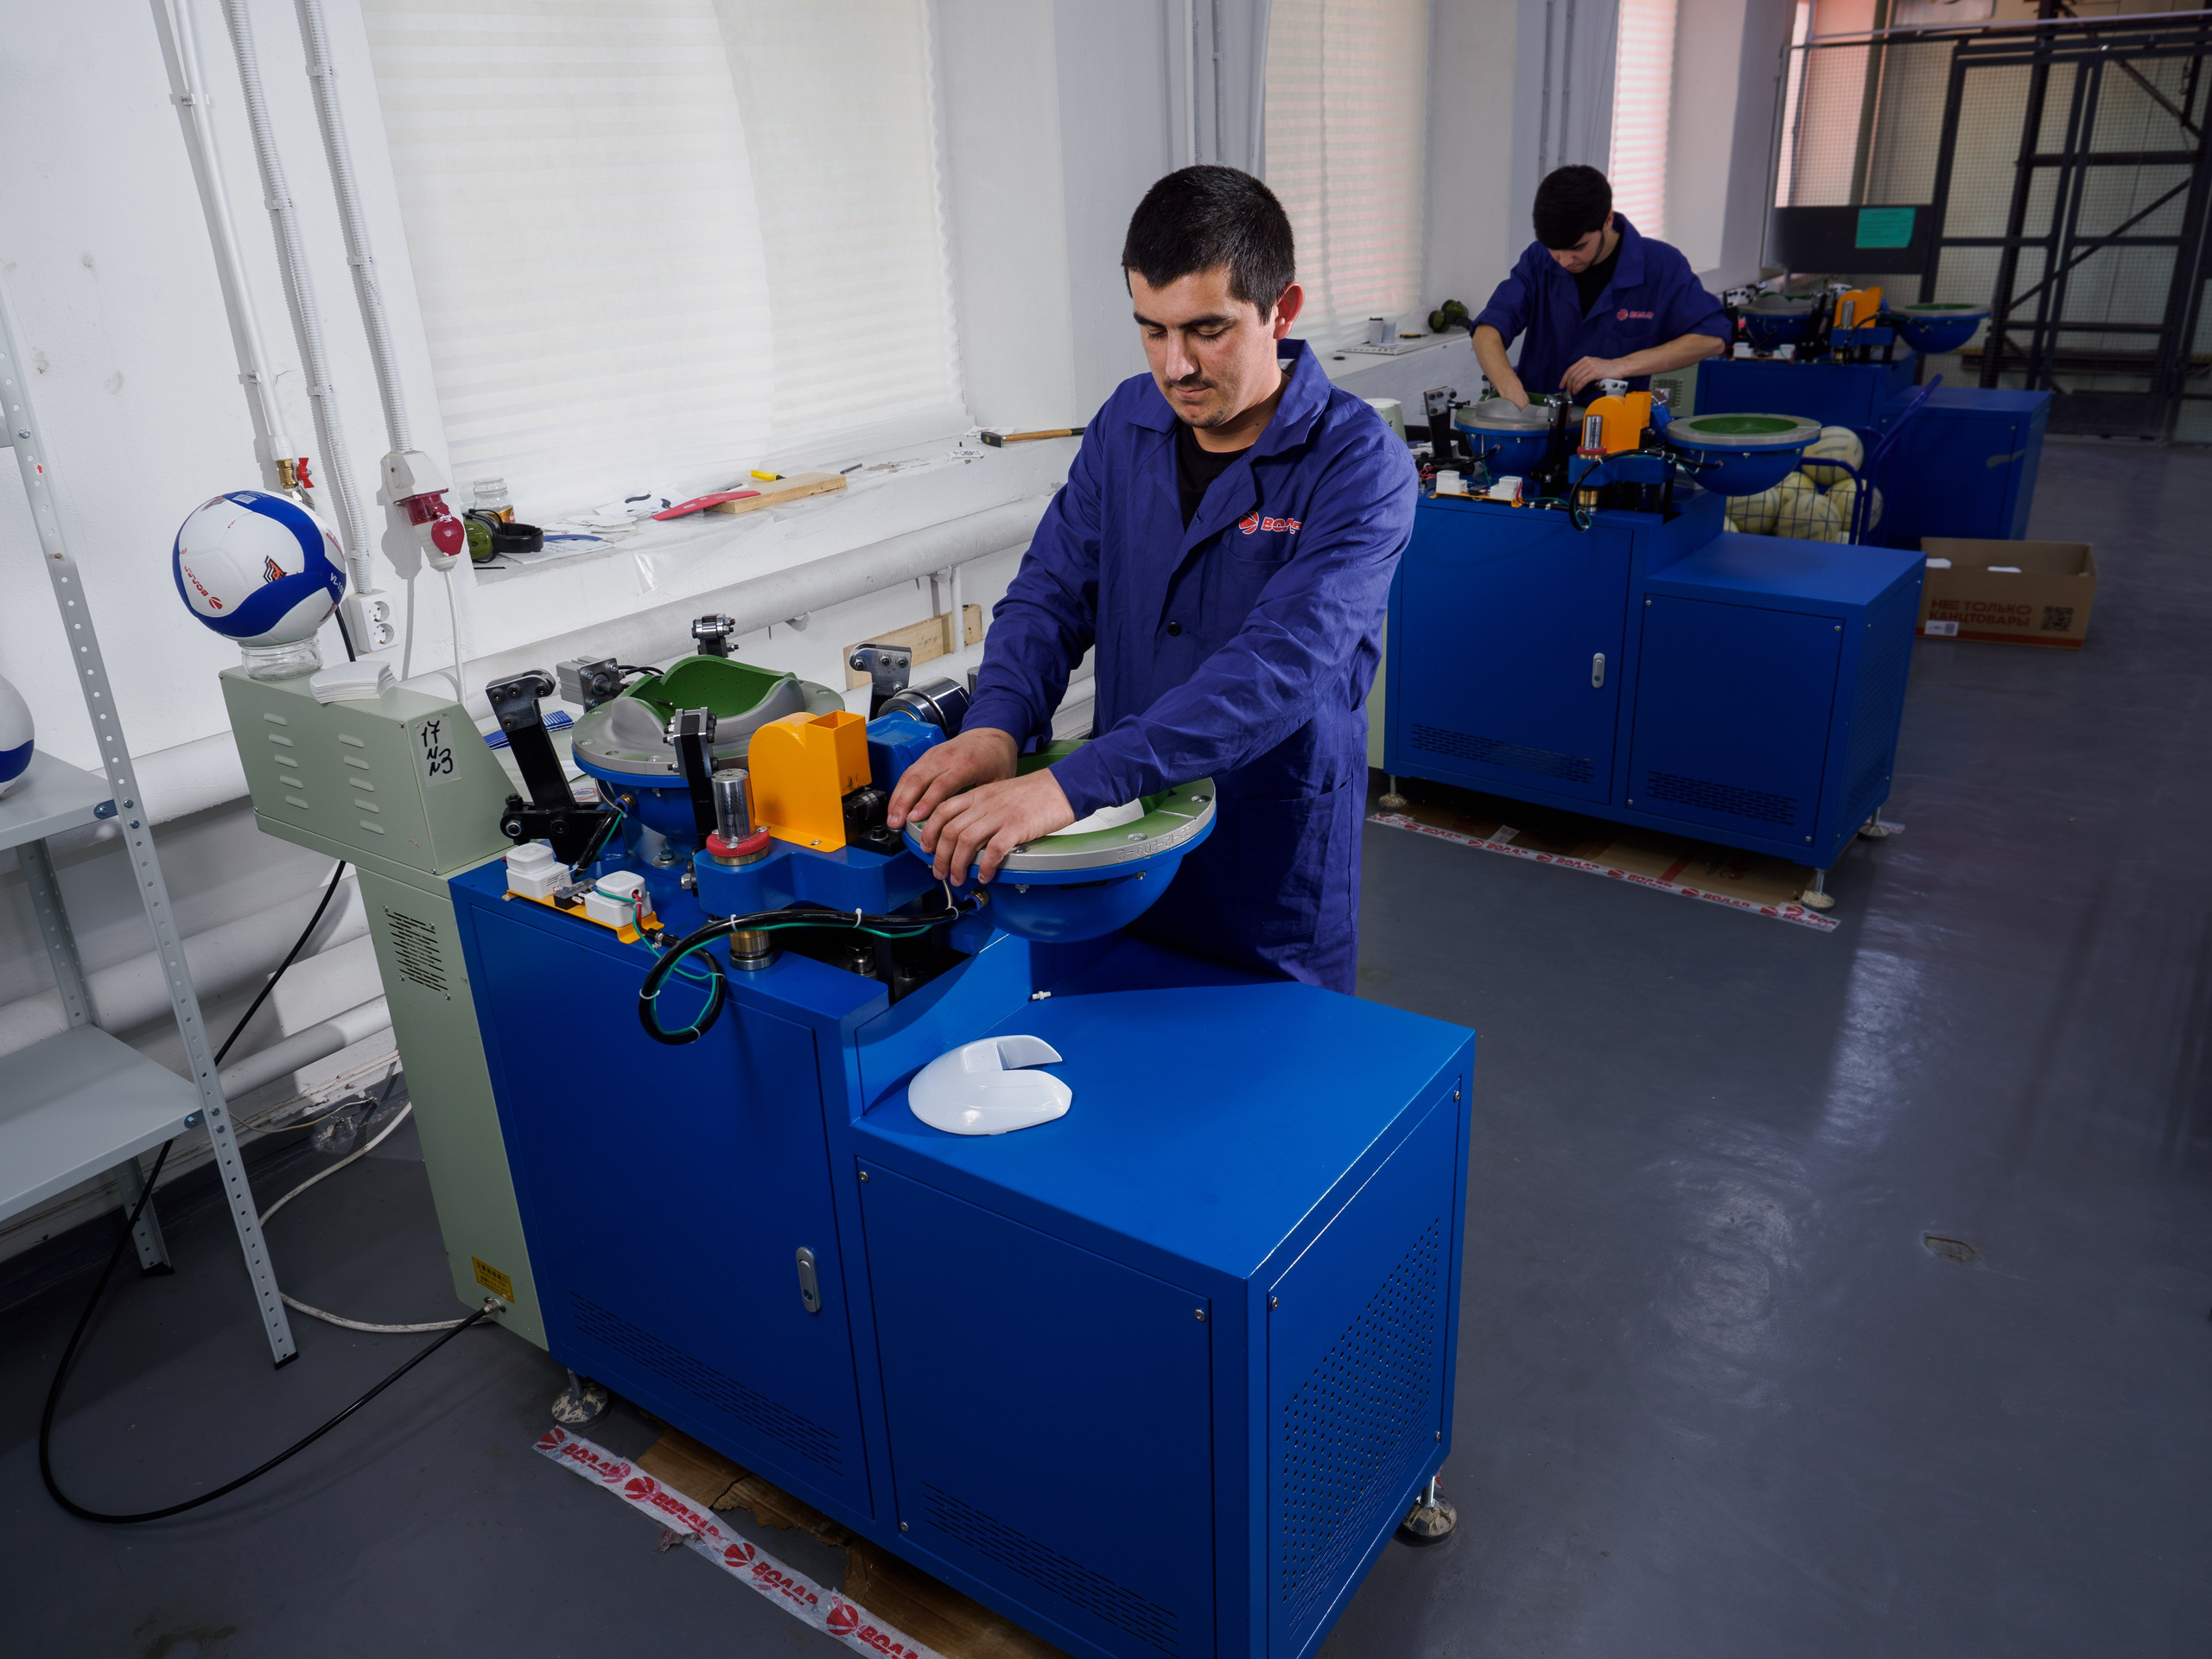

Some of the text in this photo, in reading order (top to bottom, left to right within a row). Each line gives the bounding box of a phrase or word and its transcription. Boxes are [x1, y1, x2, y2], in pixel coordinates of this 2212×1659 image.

[1931, 600, 2032, 615] НЕ ТОЛЬКО
[1929, 610, 2031, 626] КАНЦТОВАРЫ
